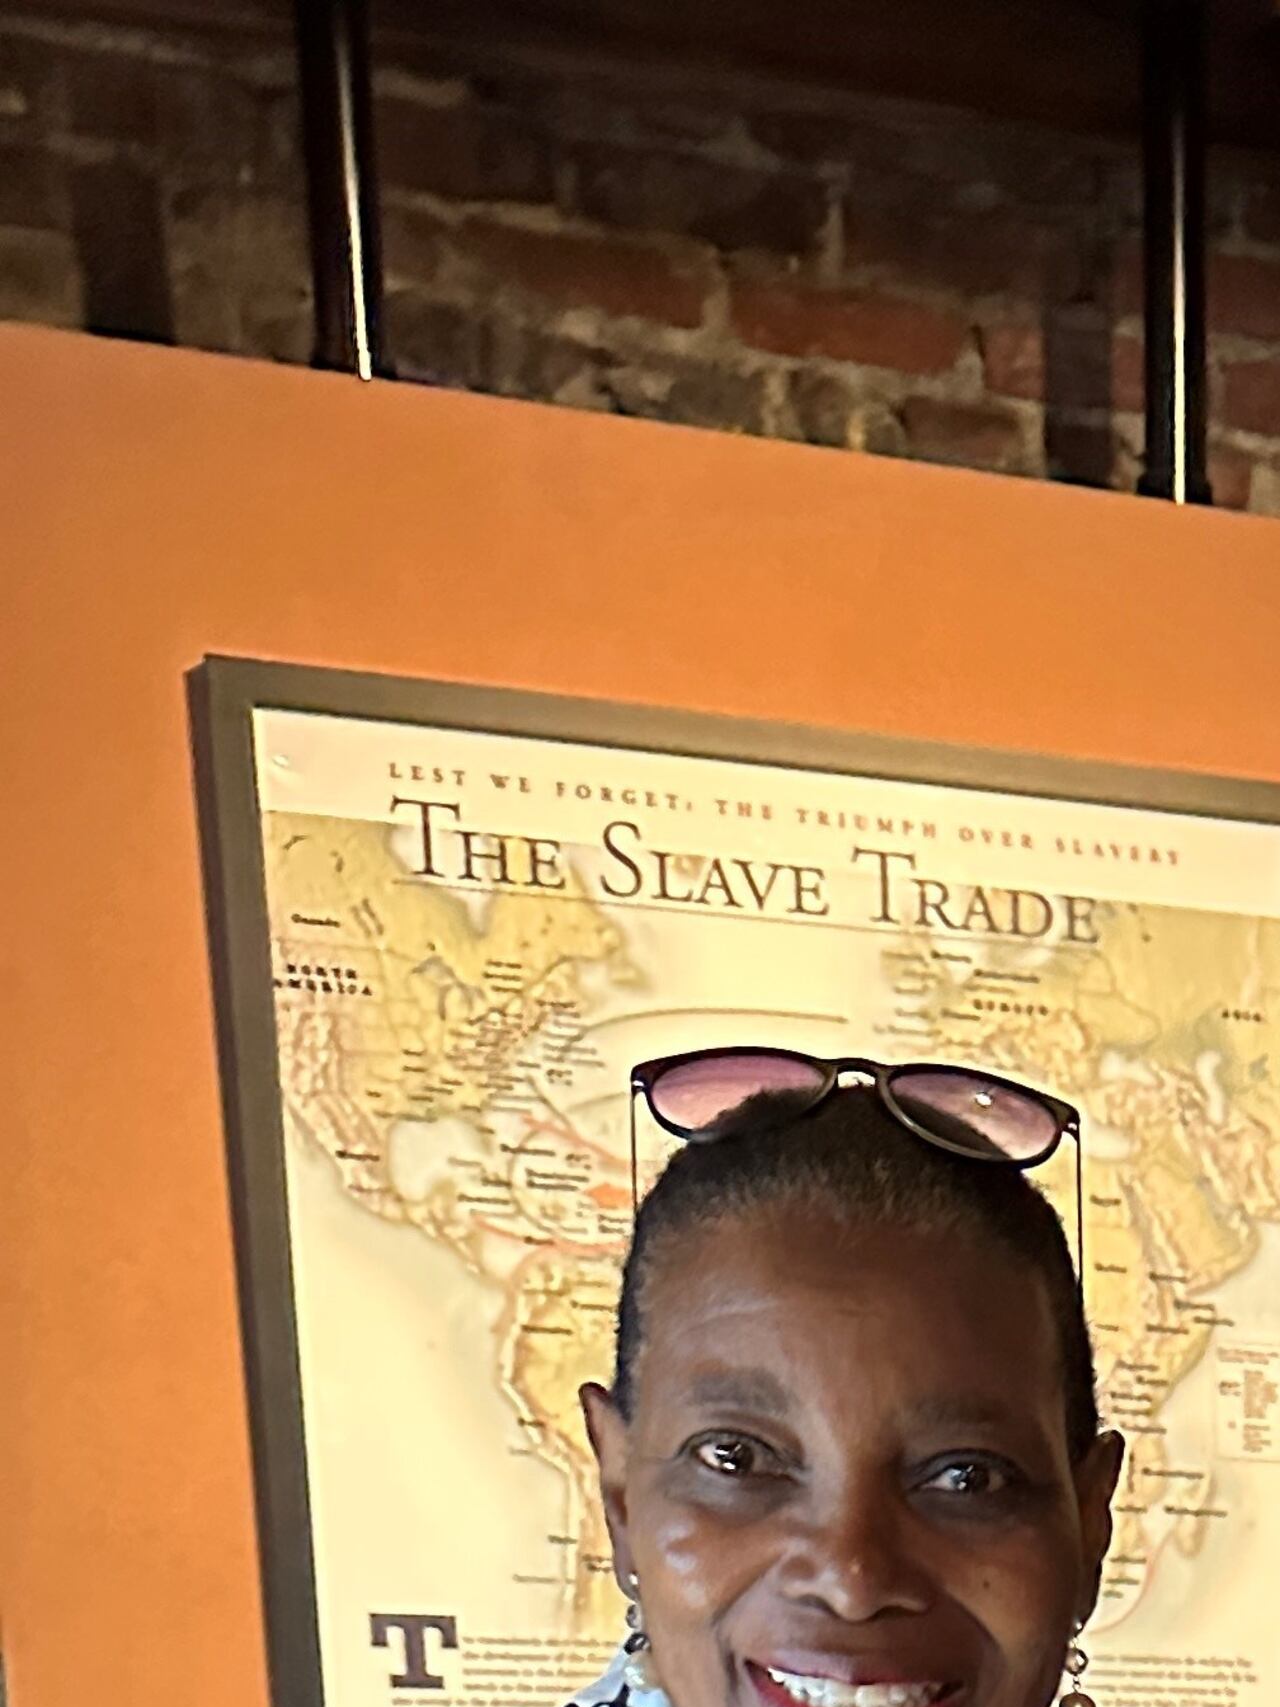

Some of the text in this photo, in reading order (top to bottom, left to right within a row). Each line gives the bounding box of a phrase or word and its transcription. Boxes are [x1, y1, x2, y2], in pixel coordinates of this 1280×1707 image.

[389, 762, 466, 786] LEST
[490, 773, 531, 793] WE
[715, 799, 772, 820] THE
[797, 808, 936, 839] TRIUMPH
[959, 826, 1033, 850] OVER
[1055, 837, 1180, 866] SLAVERY
[390, 795, 1099, 944] THE SLAVE TRADE
[369, 1613, 459, 1689] T
